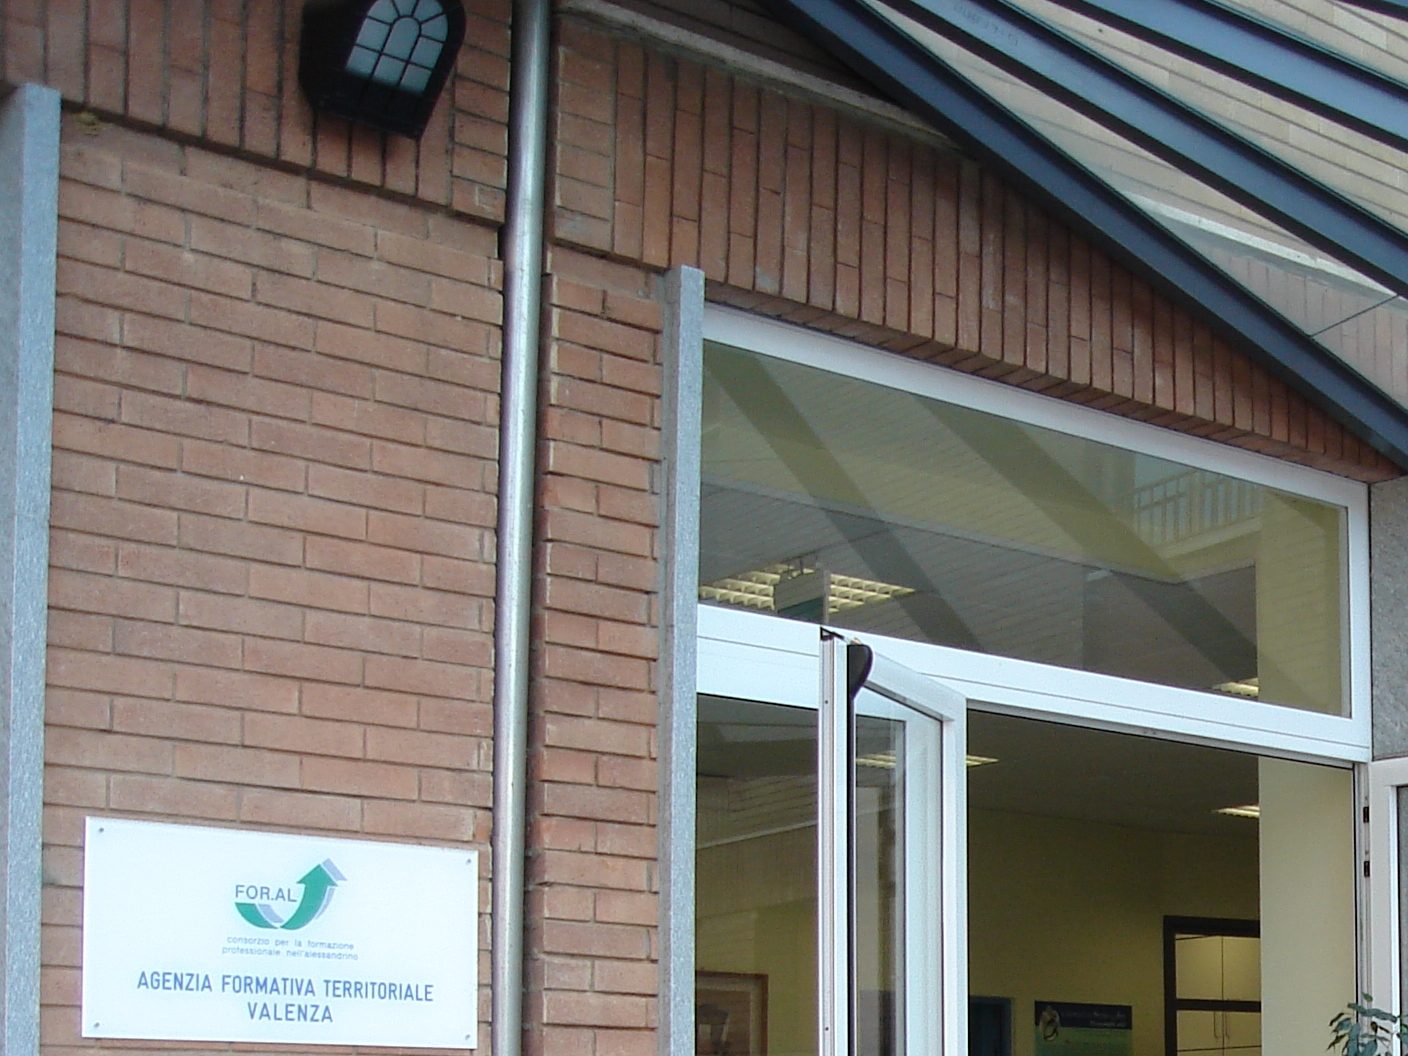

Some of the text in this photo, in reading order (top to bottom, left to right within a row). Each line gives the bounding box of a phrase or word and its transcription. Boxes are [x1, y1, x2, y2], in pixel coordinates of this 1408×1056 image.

[235, 884, 298, 902] FOR.AL
[222, 945, 359, 960] professionale nell'alessandrino
[226, 936, 354, 951] consorzio per la formazione
[137, 970, 434, 1002] AGENZIA FORMATIVA TERRITORIALE
[247, 1001, 333, 1023] VALENZA
